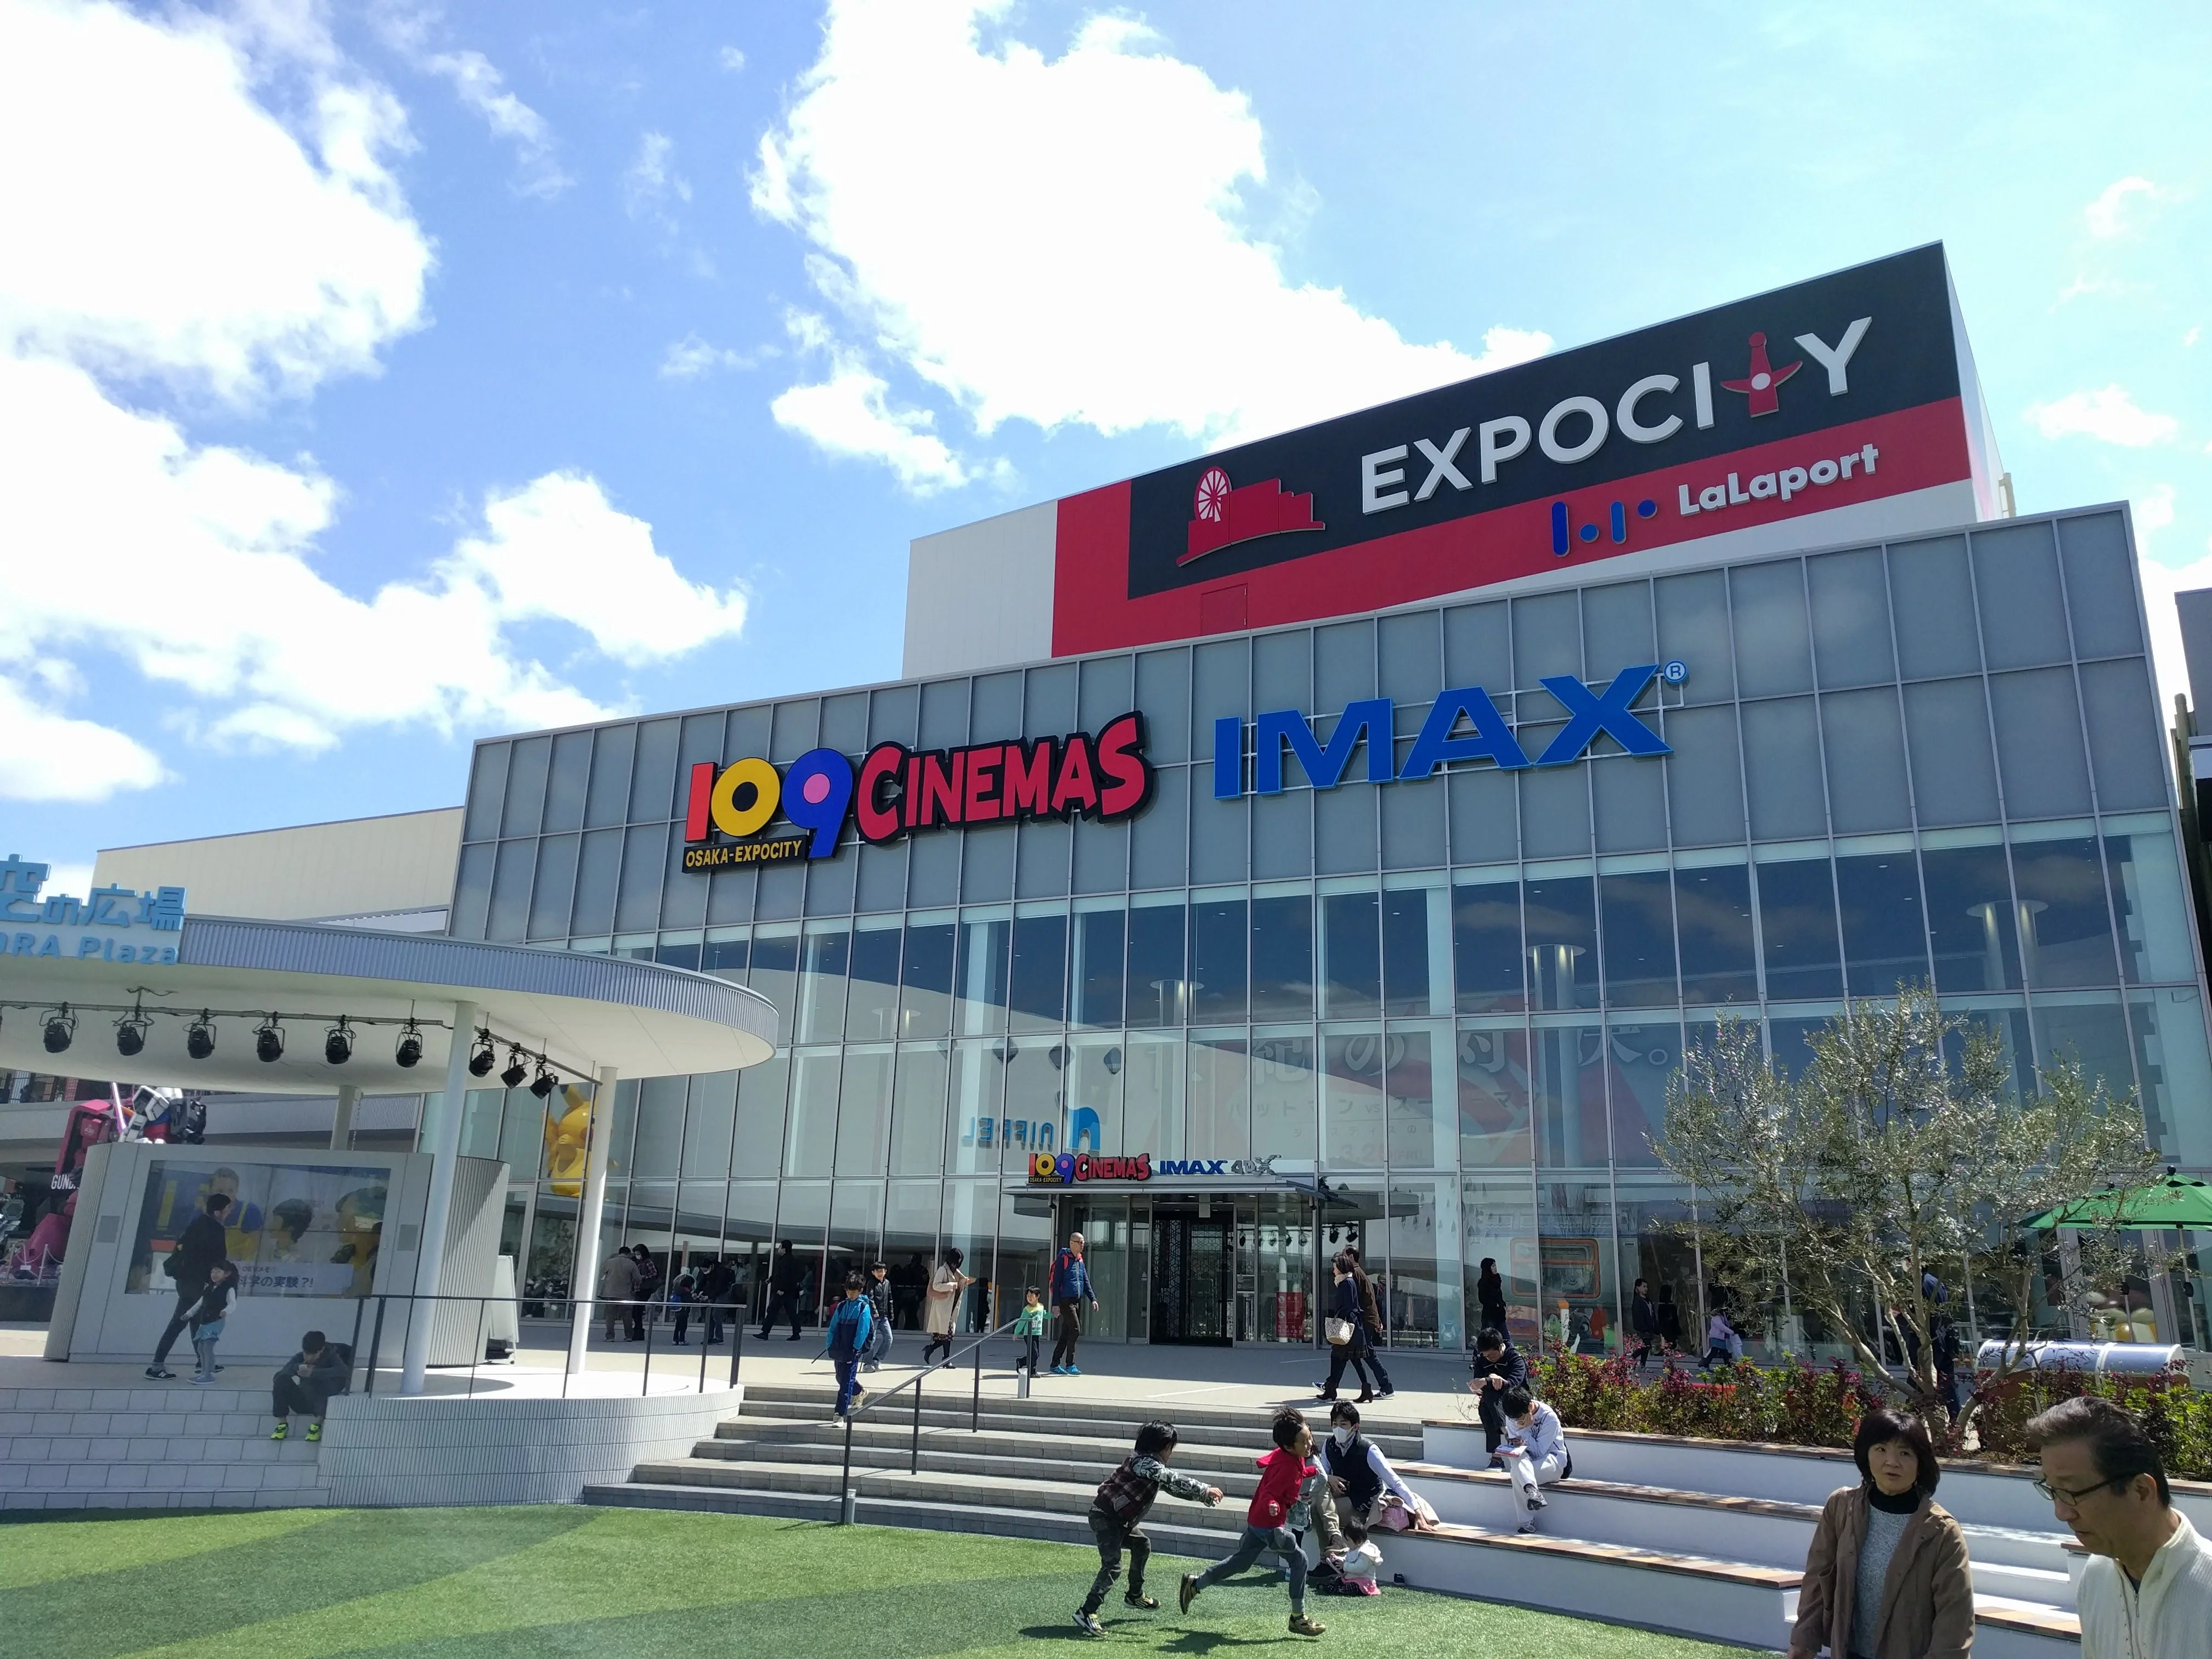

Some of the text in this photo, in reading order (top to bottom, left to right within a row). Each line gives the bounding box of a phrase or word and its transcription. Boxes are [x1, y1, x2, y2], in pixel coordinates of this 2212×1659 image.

[1679, 443, 1879, 516] LaLaport
[685, 712, 1150, 859] 109 CINEMAS
[686, 840, 803, 867] OSAKA-EXPOCITY
[77, 936, 179, 966] Plaza
[1029, 1153, 1076, 1184] 109
[1075, 1153, 1151, 1181] CINEMAS
